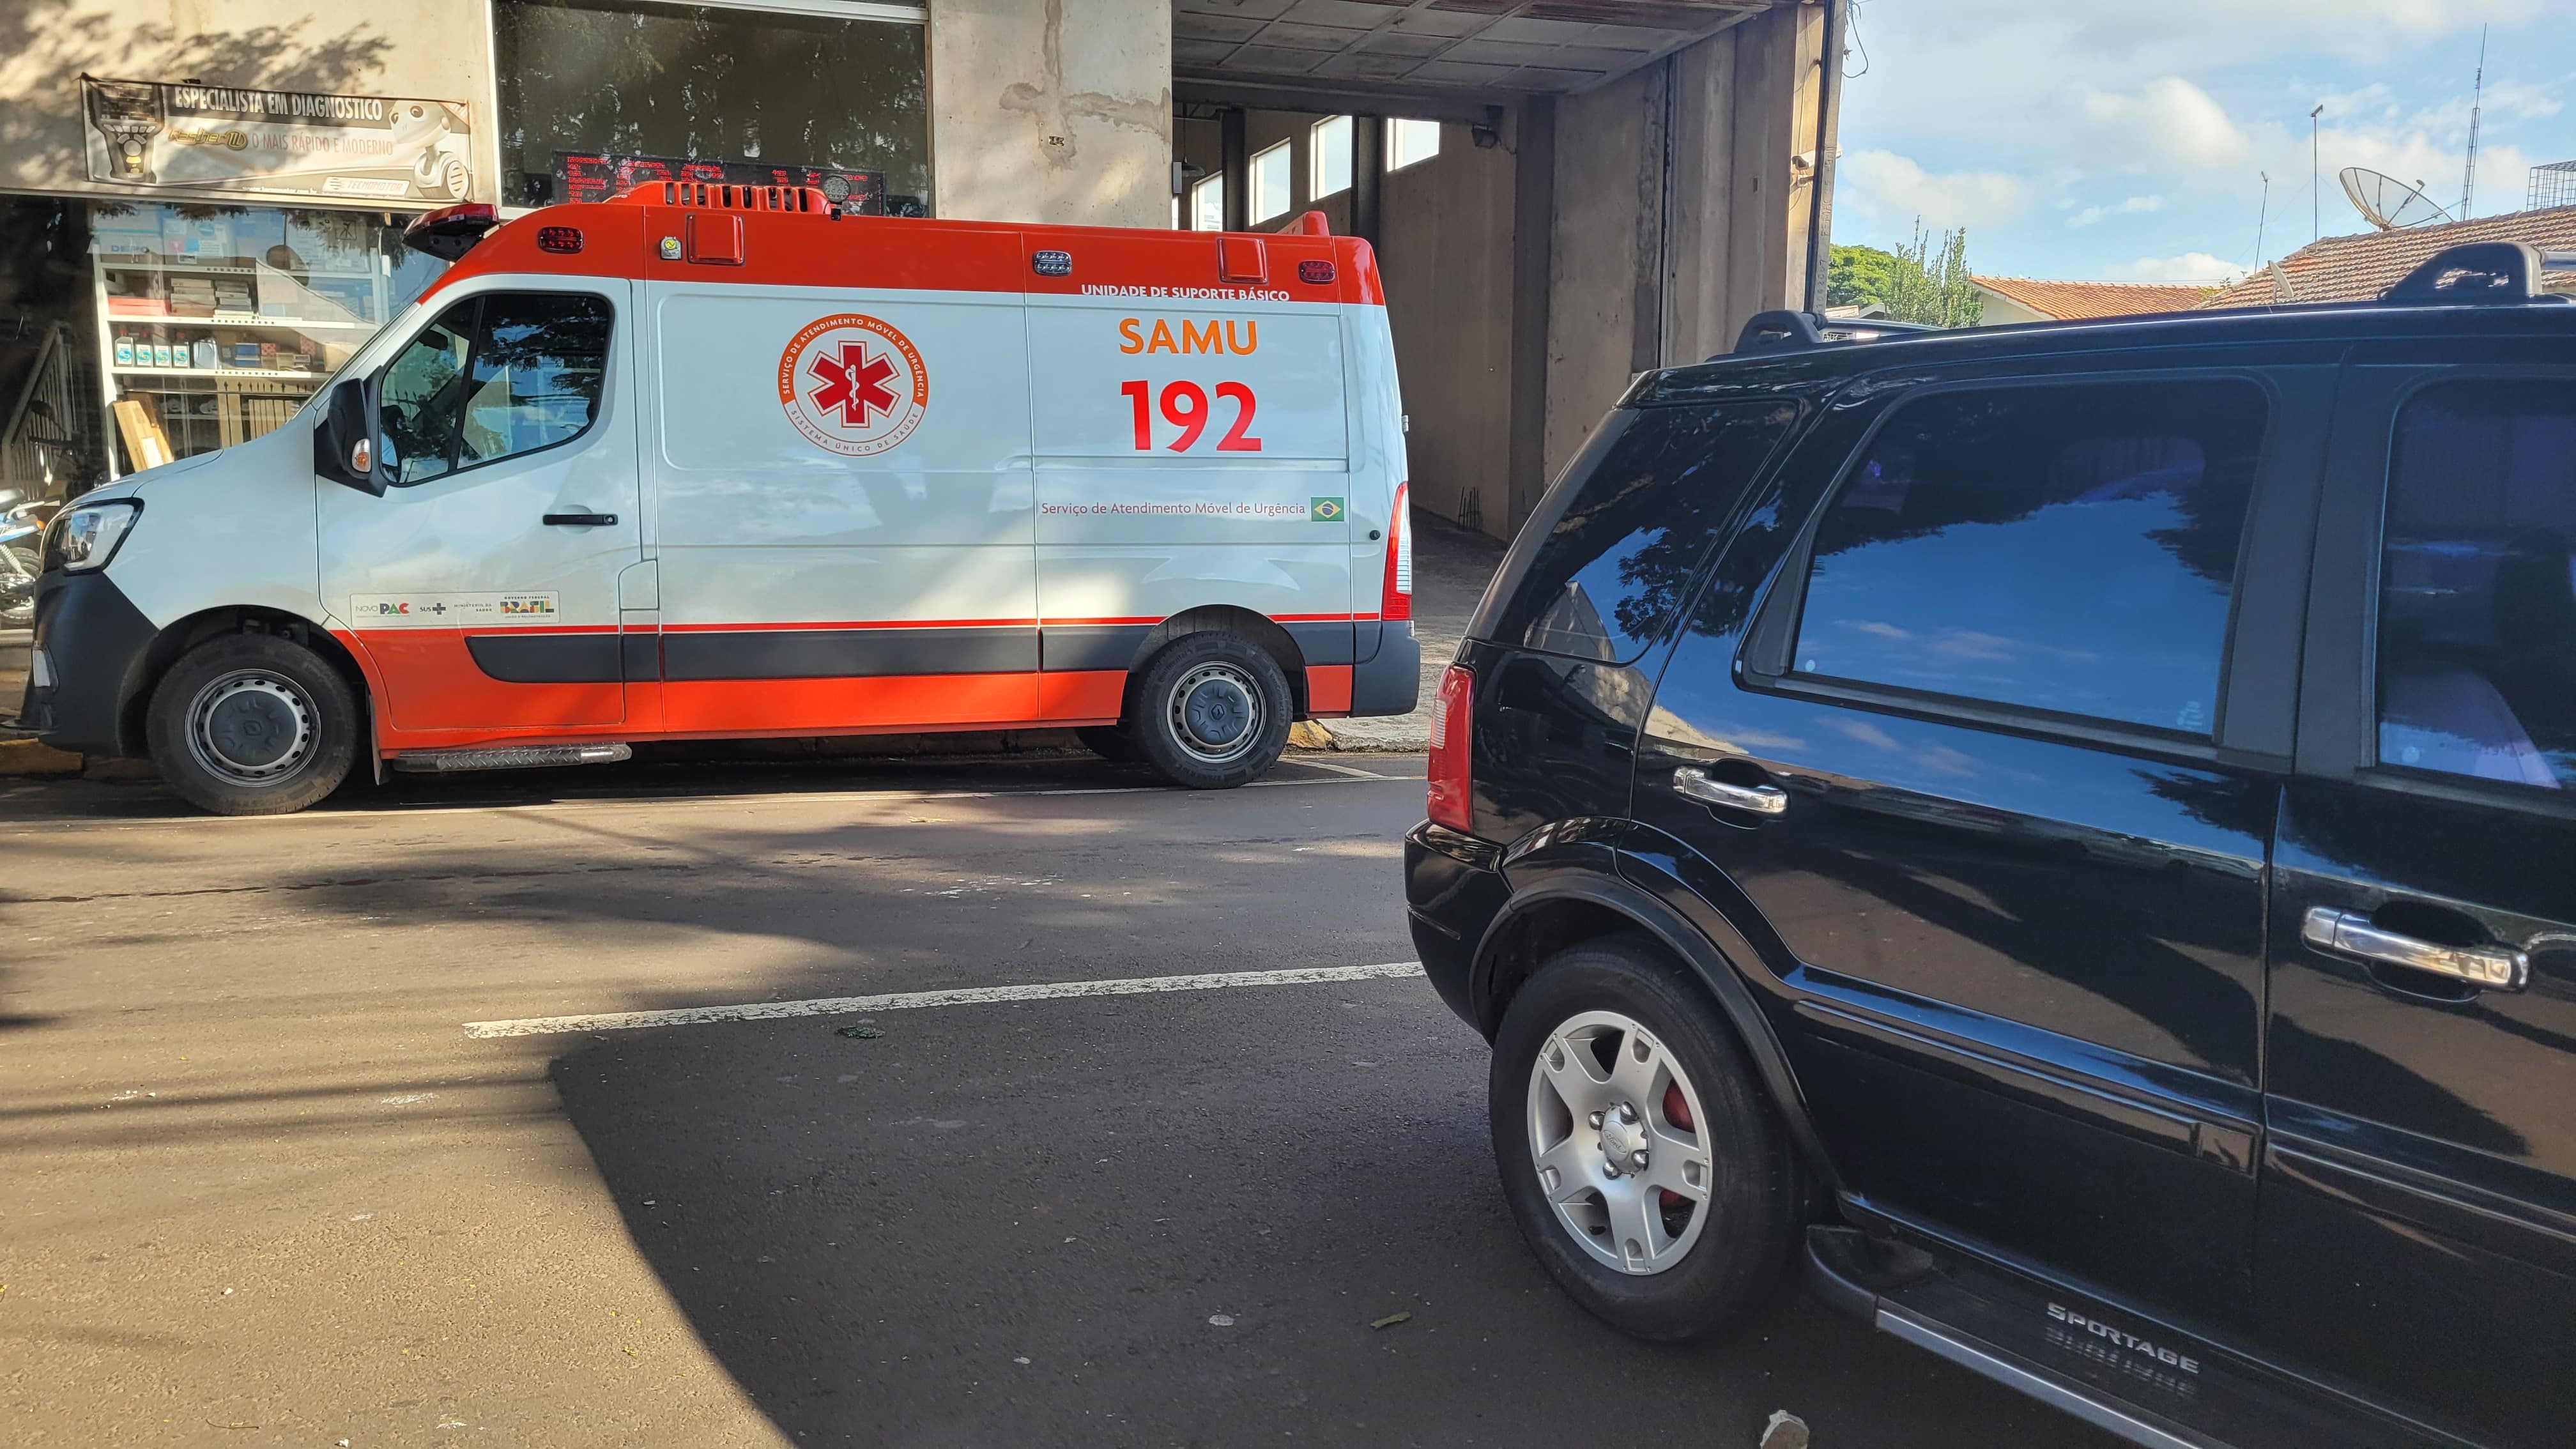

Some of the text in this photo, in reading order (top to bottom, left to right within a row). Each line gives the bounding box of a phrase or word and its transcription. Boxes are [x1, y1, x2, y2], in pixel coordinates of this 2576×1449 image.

[174, 86, 383, 121] ESPECIALISTA EM DIAGNOSTICO
[252, 131, 393, 156] O MAIS RÁPIDO E MODERNO
[1081, 284, 1290, 302] UNIDADE DE SUPORTE BÁSICO
[1119, 318, 1258, 355] SAMU
[783, 318, 926, 398] SERVIÇO DE ATENDIMENTO MÓVEL DE URGÊNCIA
[791, 410, 919, 452] SISTEMA ÚNICO DE SAÚDE
[1120, 379, 1262, 454] 192
[1041, 502, 1305, 517] Serviço de Atendimento Móvel de Urgência
[379, 602, 410, 615] PAC
[500, 600, 555, 614] BRASIL
[2046, 1301, 2200, 1374] SPORTAGE
